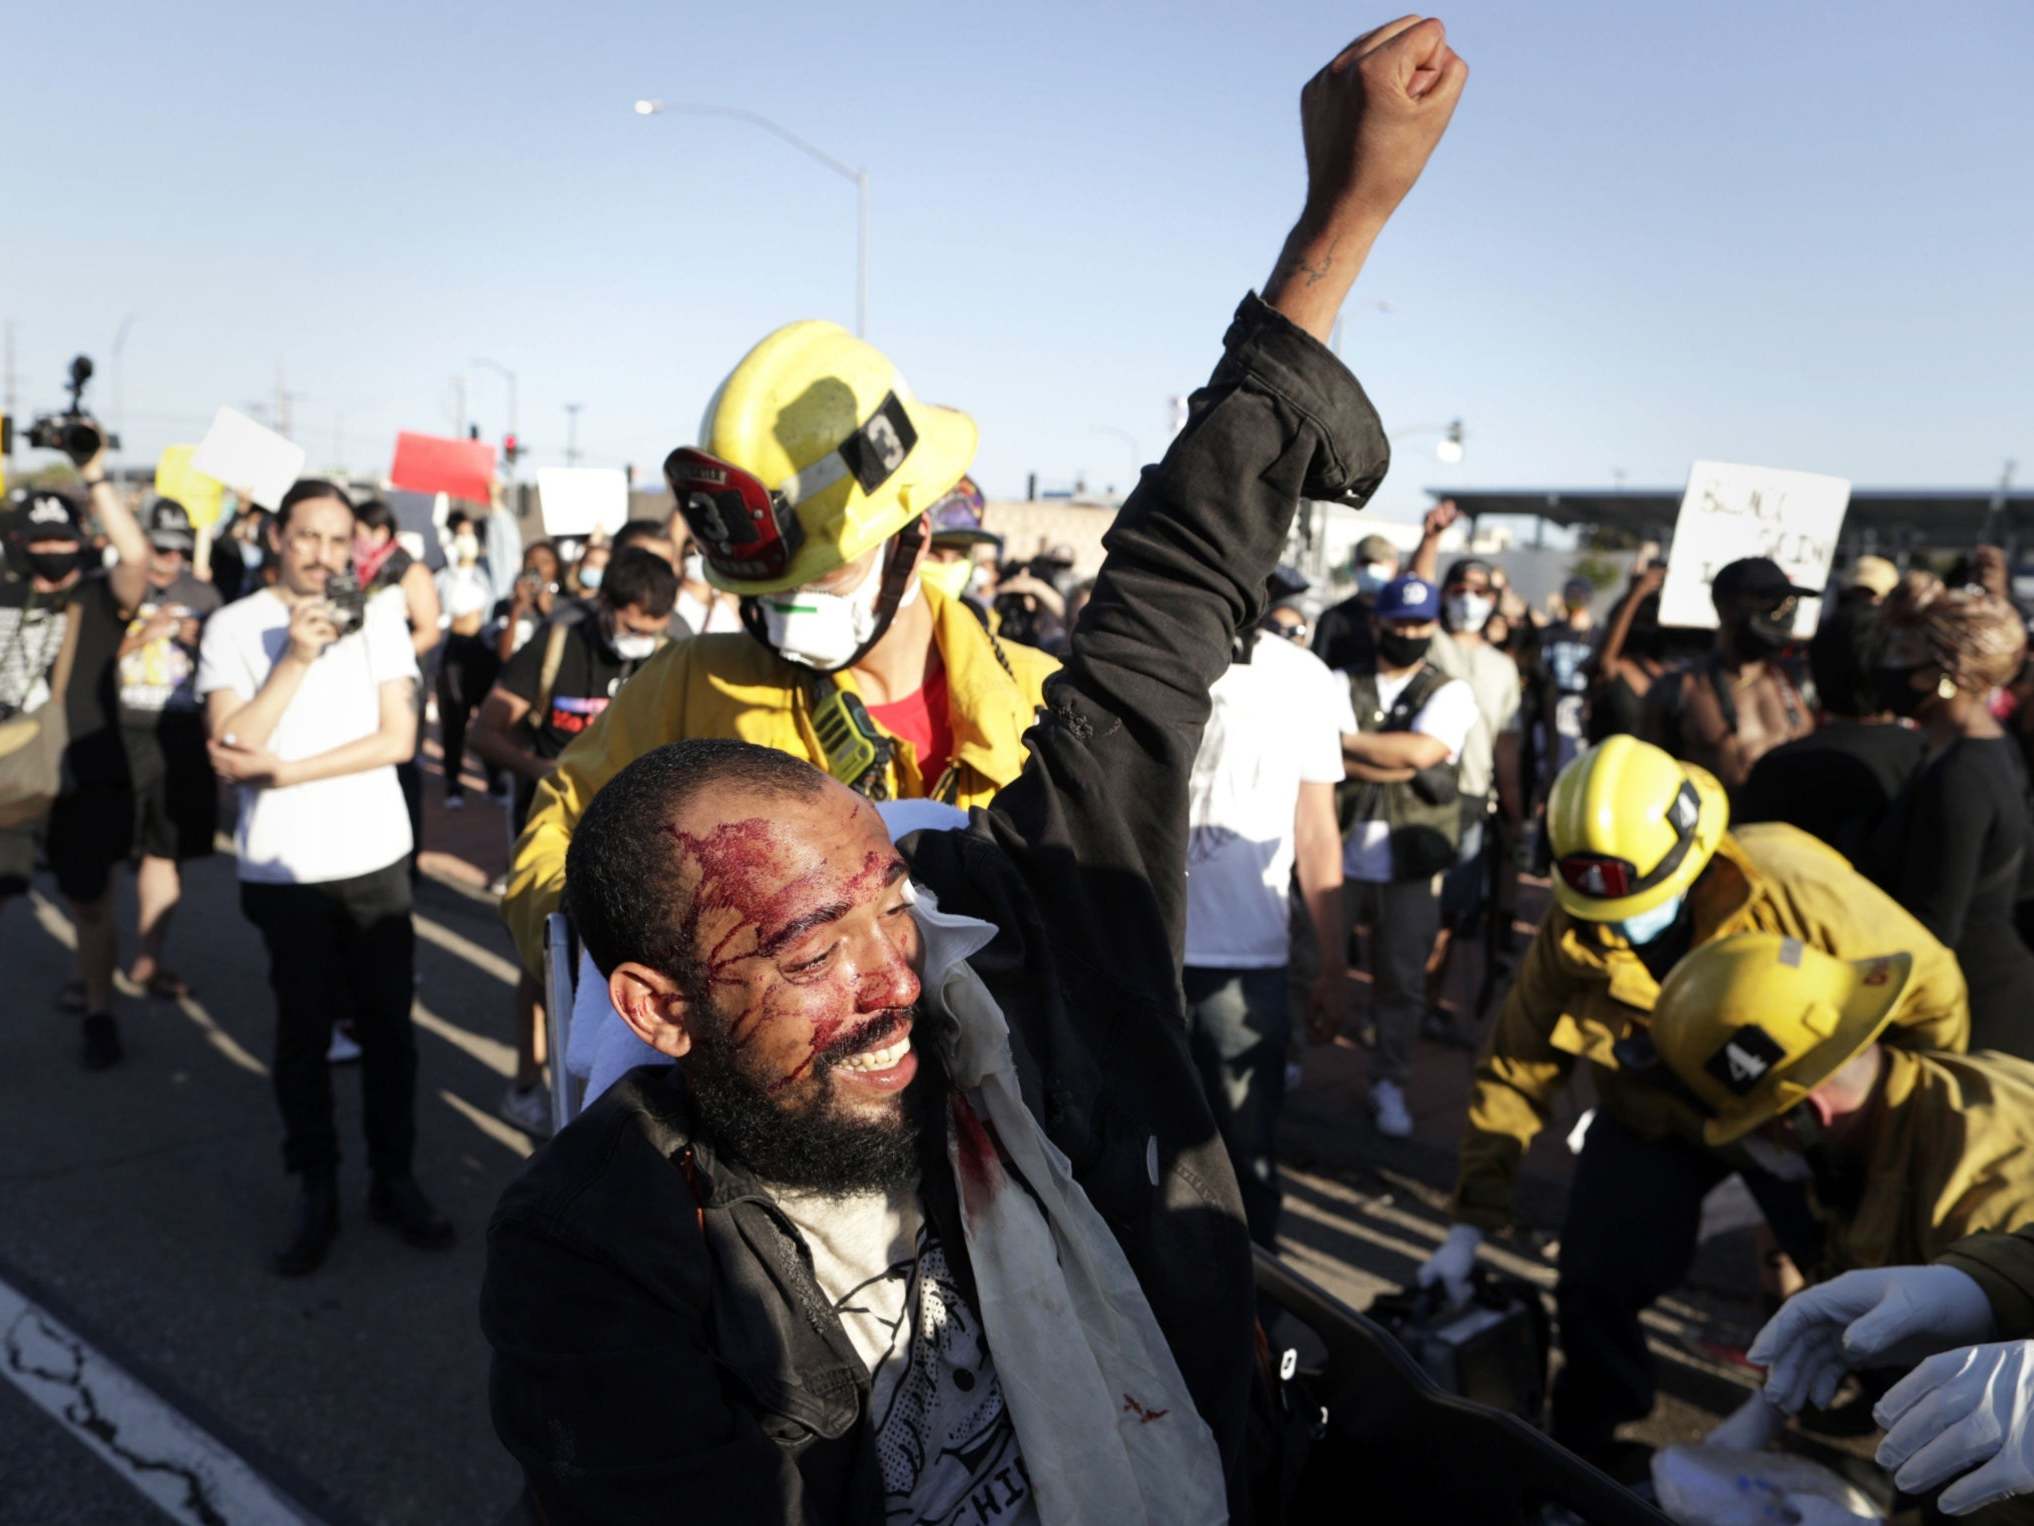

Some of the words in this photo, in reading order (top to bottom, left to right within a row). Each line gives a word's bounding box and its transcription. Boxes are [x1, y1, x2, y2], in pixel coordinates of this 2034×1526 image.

[867, 412, 905, 471] 3
[688, 491, 730, 541] 3
[1726, 1042, 1768, 1081] 4
